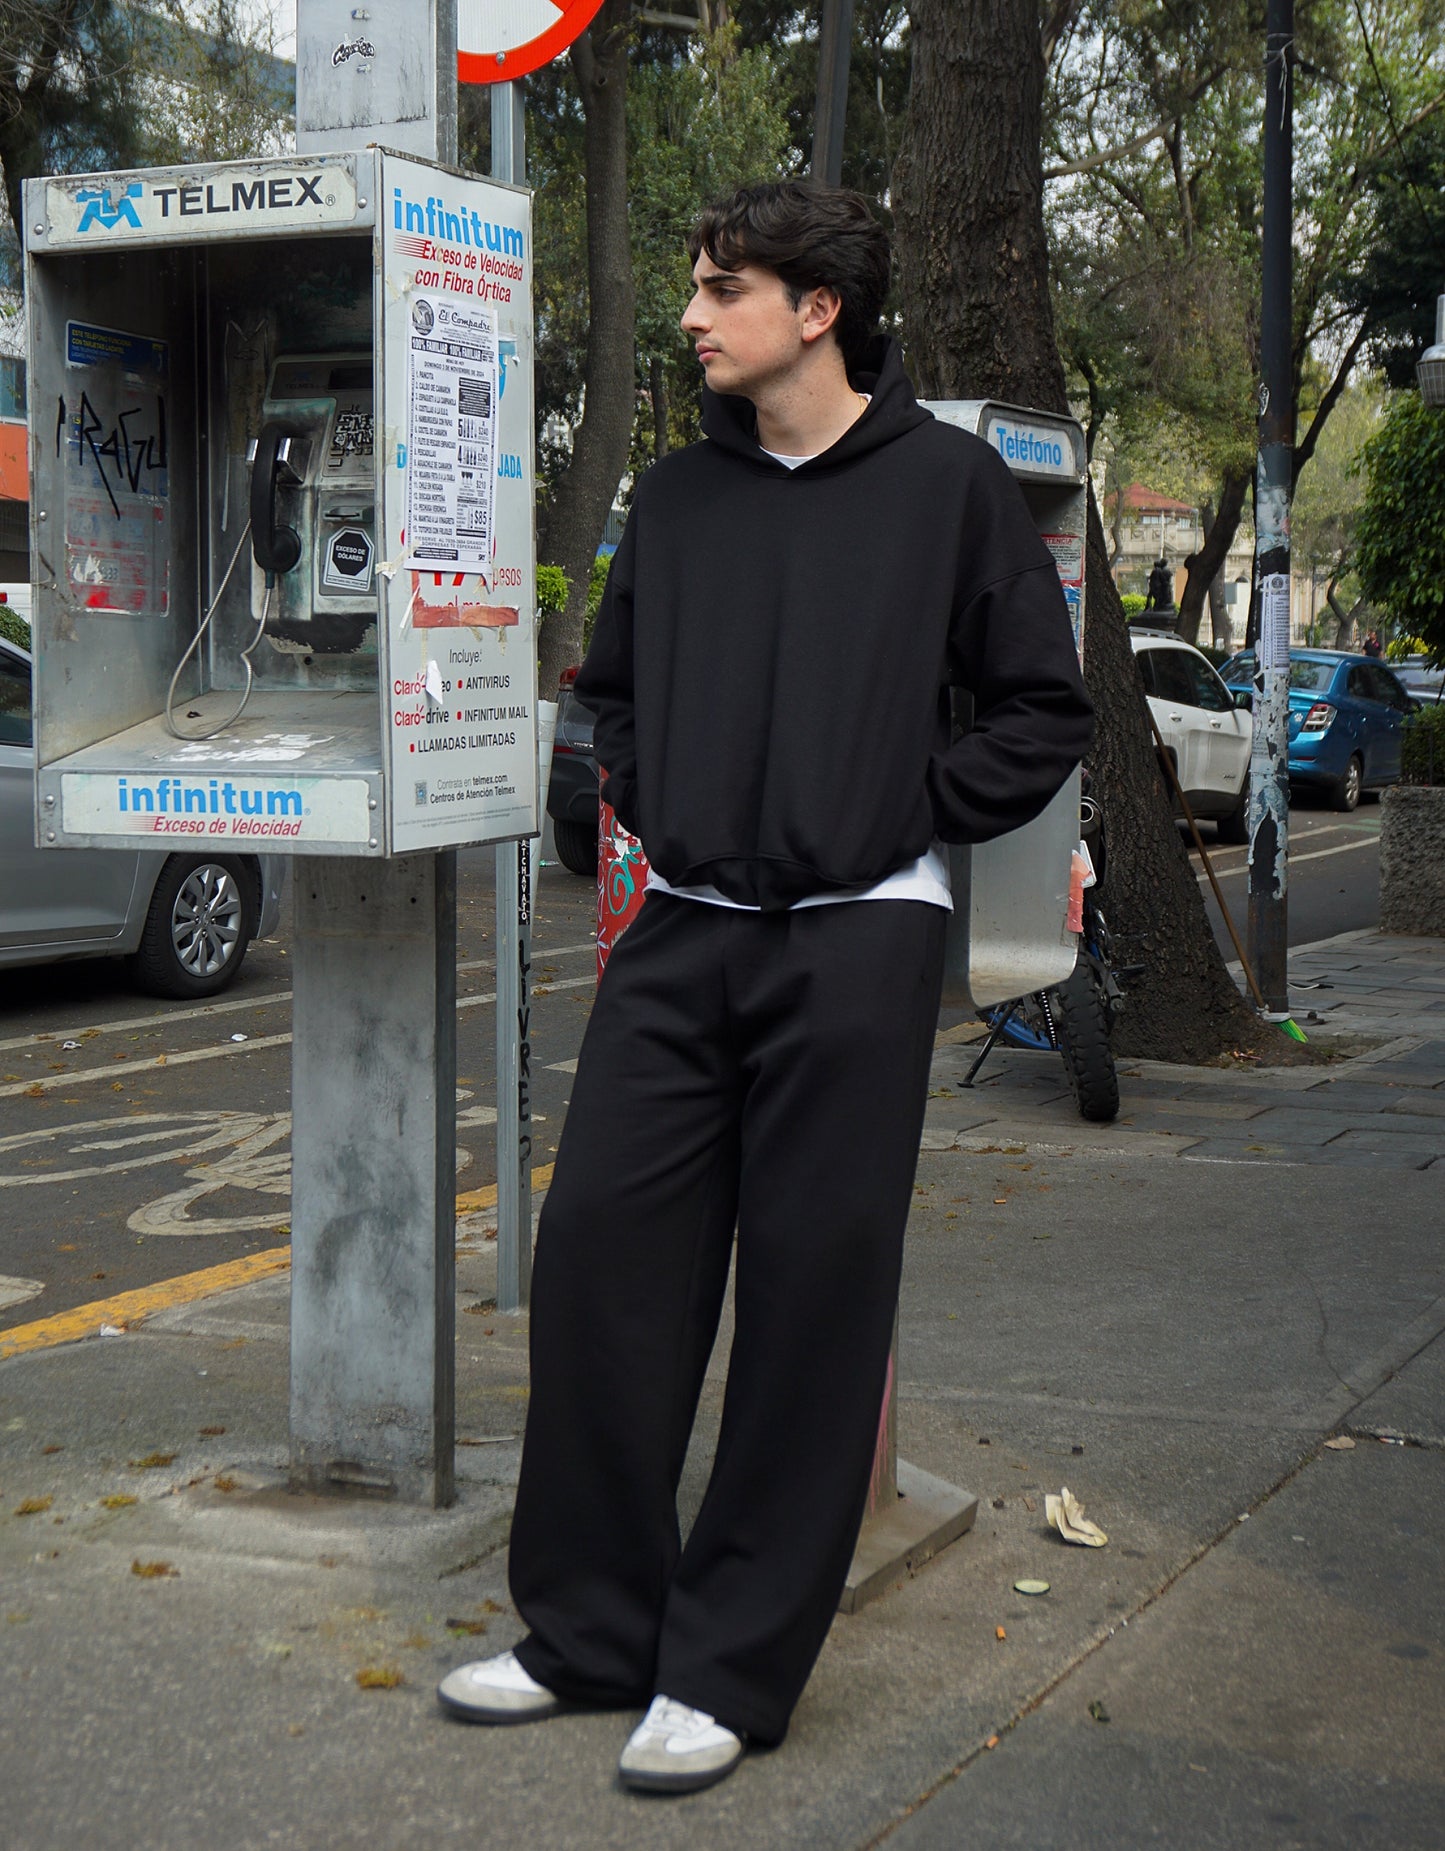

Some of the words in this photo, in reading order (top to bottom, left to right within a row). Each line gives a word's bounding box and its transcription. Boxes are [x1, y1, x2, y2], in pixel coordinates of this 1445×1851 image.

[153, 175, 324, 218] TELMEX
[394, 188, 523, 259] infinitum
[464, 251, 476, 270] de
[480, 253, 523, 281] Velocidad
[415, 269, 439, 288] con
[443, 271, 473, 295] Fibra
[438, 309, 449, 323] El
[451, 311, 491, 333] Compadre
[458, 418, 463, 437] 5
[458, 445, 462, 463] 4
[996, 427, 1062, 466] Teléfono
[474, 510, 487, 525] $85
[335, 545, 357, 554] EXCESO
[357, 548, 366, 556] DE
[492, 568, 522, 592] pesos
[449, 648, 483, 668] Incluye:
[466, 675, 510, 690] ANTIVIRUS
[464, 708, 507, 723] INFINITUM
[508, 706, 529, 720] MAIL
[417, 736, 467, 753] LLAMADAS
[468, 732, 516, 749] ILIMITADAS
[437, 778, 463, 790] Contrata
[464, 780, 472, 788] en
[472, 773, 508, 787] telmex.com
[118, 778, 303, 816] infinitum
[430, 791, 455, 804] Centros
[456, 790, 464, 801] de
[466, 787, 494, 800] Atención
[494, 785, 516, 797] Telmex
[153, 816, 205, 833] Exceso
[209, 817, 227, 834] de
[231, 818, 302, 836] Velocidad
